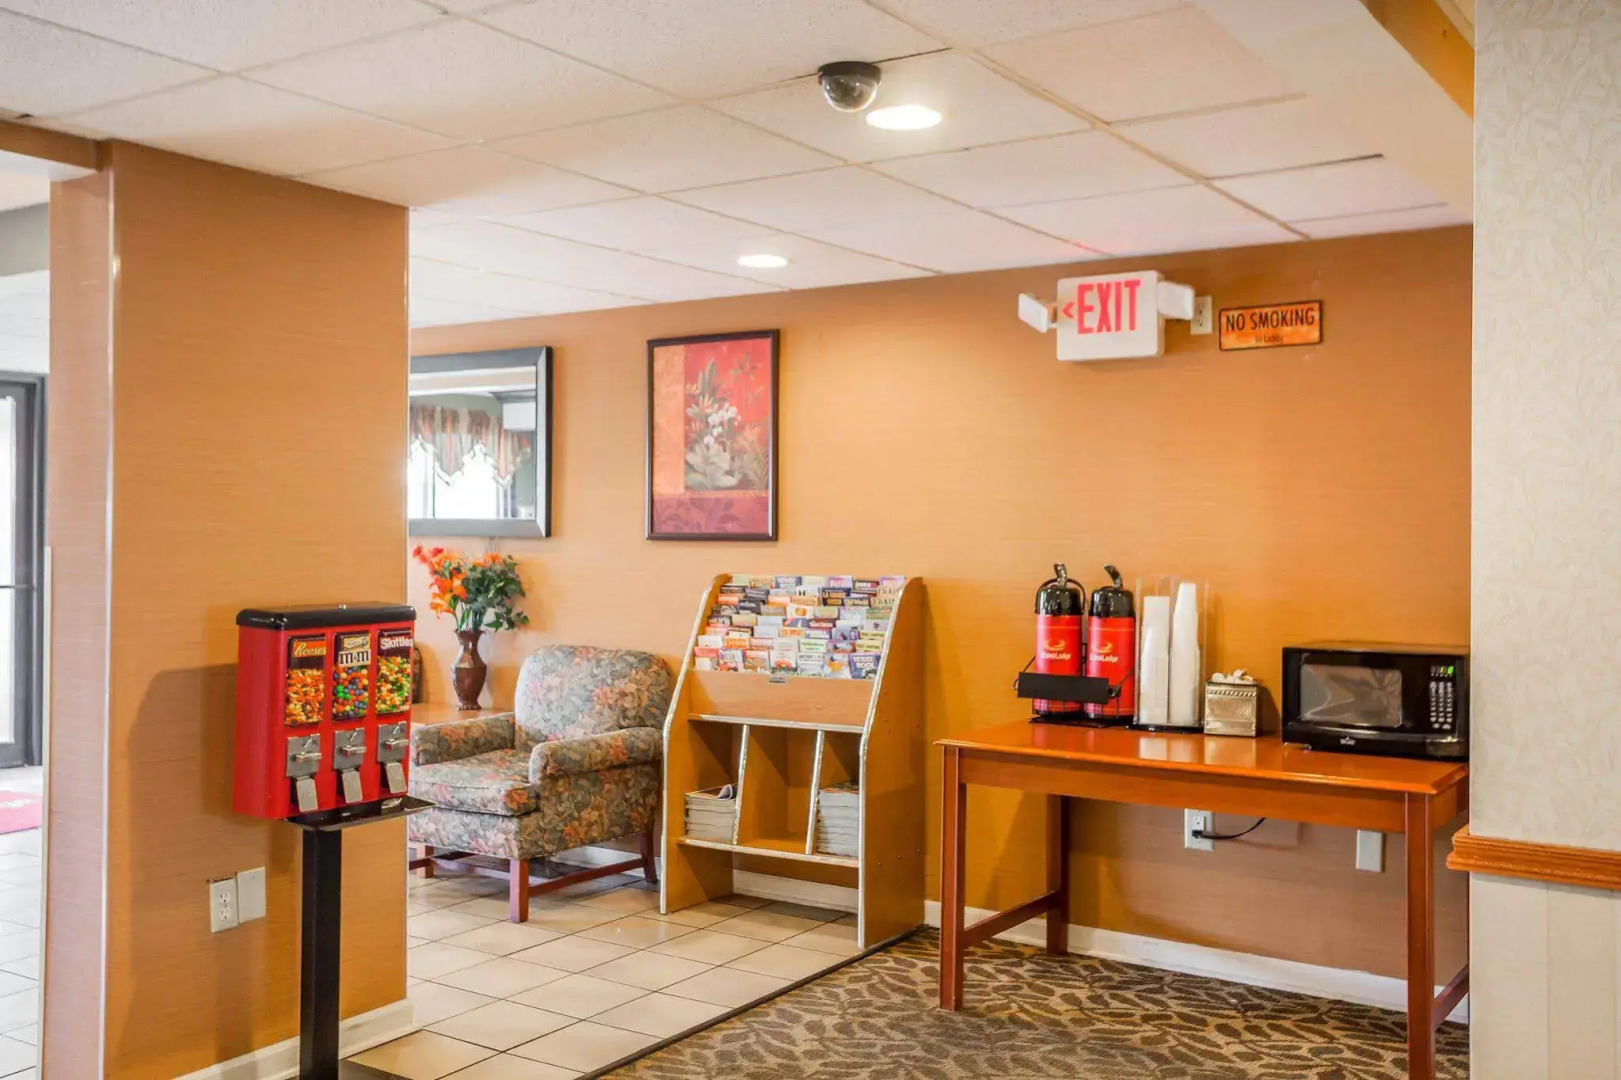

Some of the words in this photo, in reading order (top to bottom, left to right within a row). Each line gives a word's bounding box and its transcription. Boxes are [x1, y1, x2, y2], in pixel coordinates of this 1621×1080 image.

[1077, 279, 1141, 334] EXIT
[1226, 312, 1246, 332] NO
[1249, 307, 1315, 331] SMOKING
[380, 637, 414, 650] Skittles
